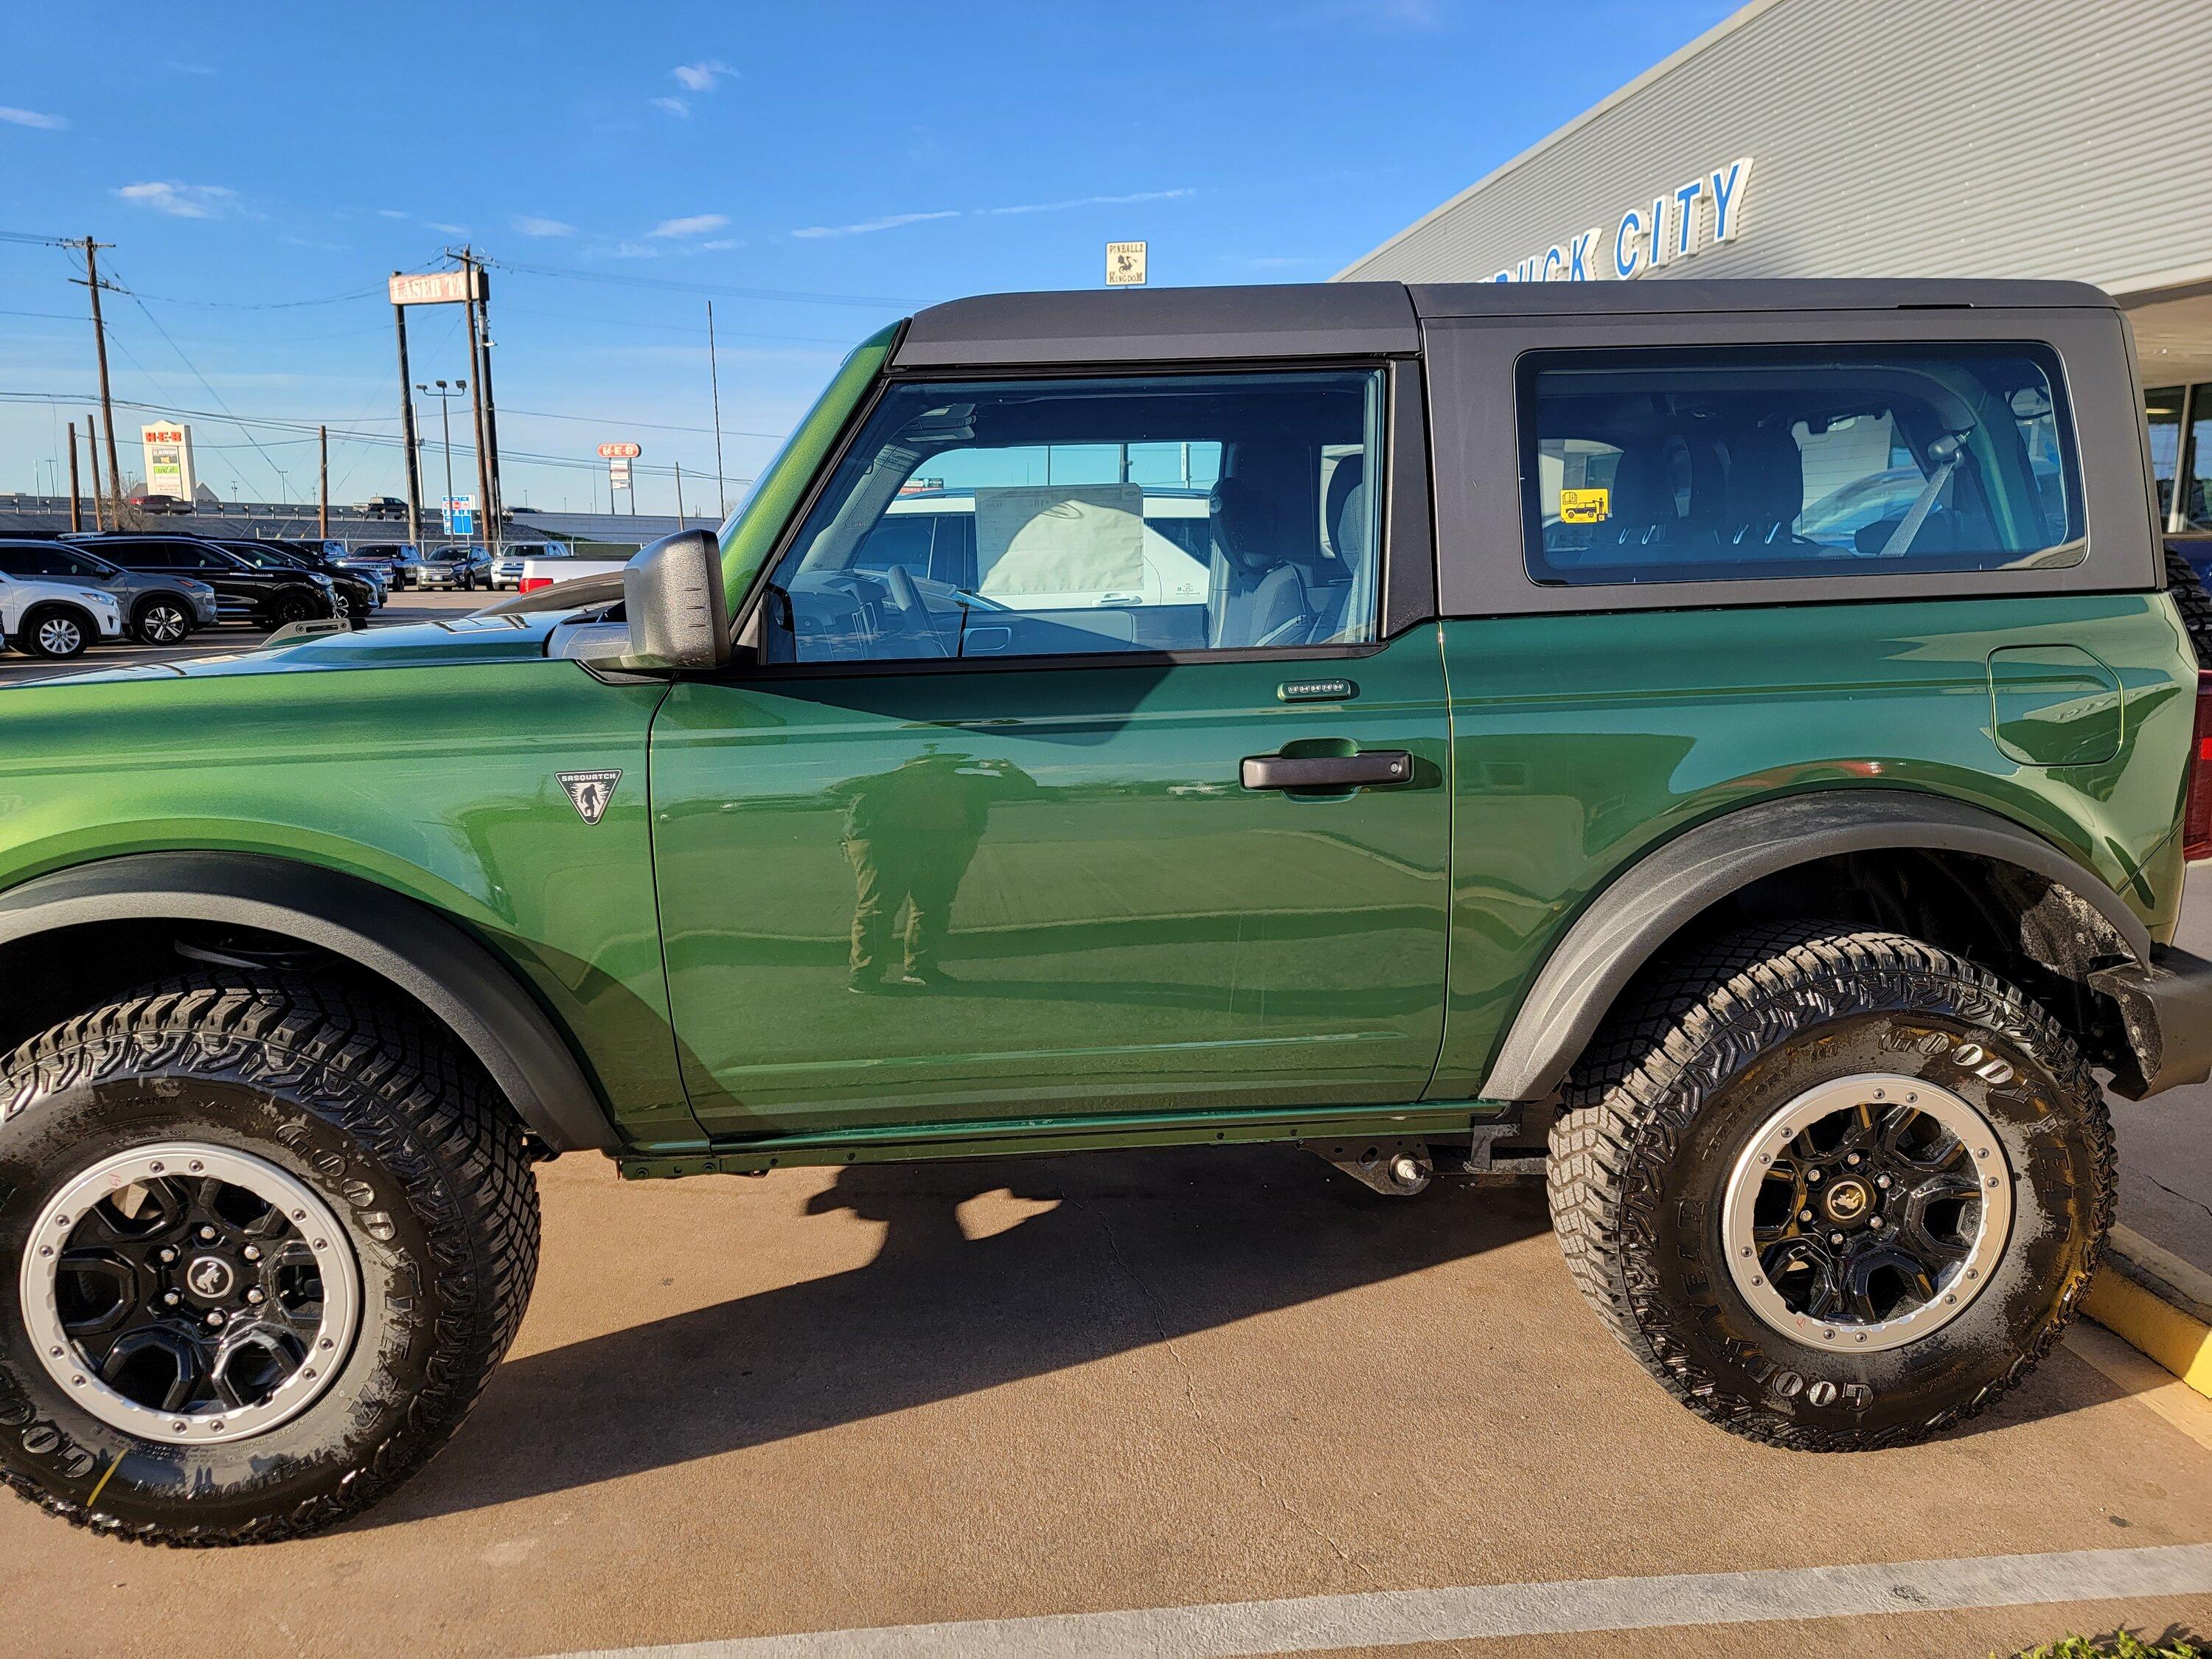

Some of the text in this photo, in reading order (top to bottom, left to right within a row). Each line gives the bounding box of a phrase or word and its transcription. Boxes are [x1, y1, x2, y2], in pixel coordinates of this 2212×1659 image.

[1613, 157, 1754, 281] CITY
[1109, 271, 1143, 282] KINGDOM
[393, 277, 442, 299] LASER
[145, 431, 182, 442] H-E-B
[561, 773, 616, 782] SASQUATCH
